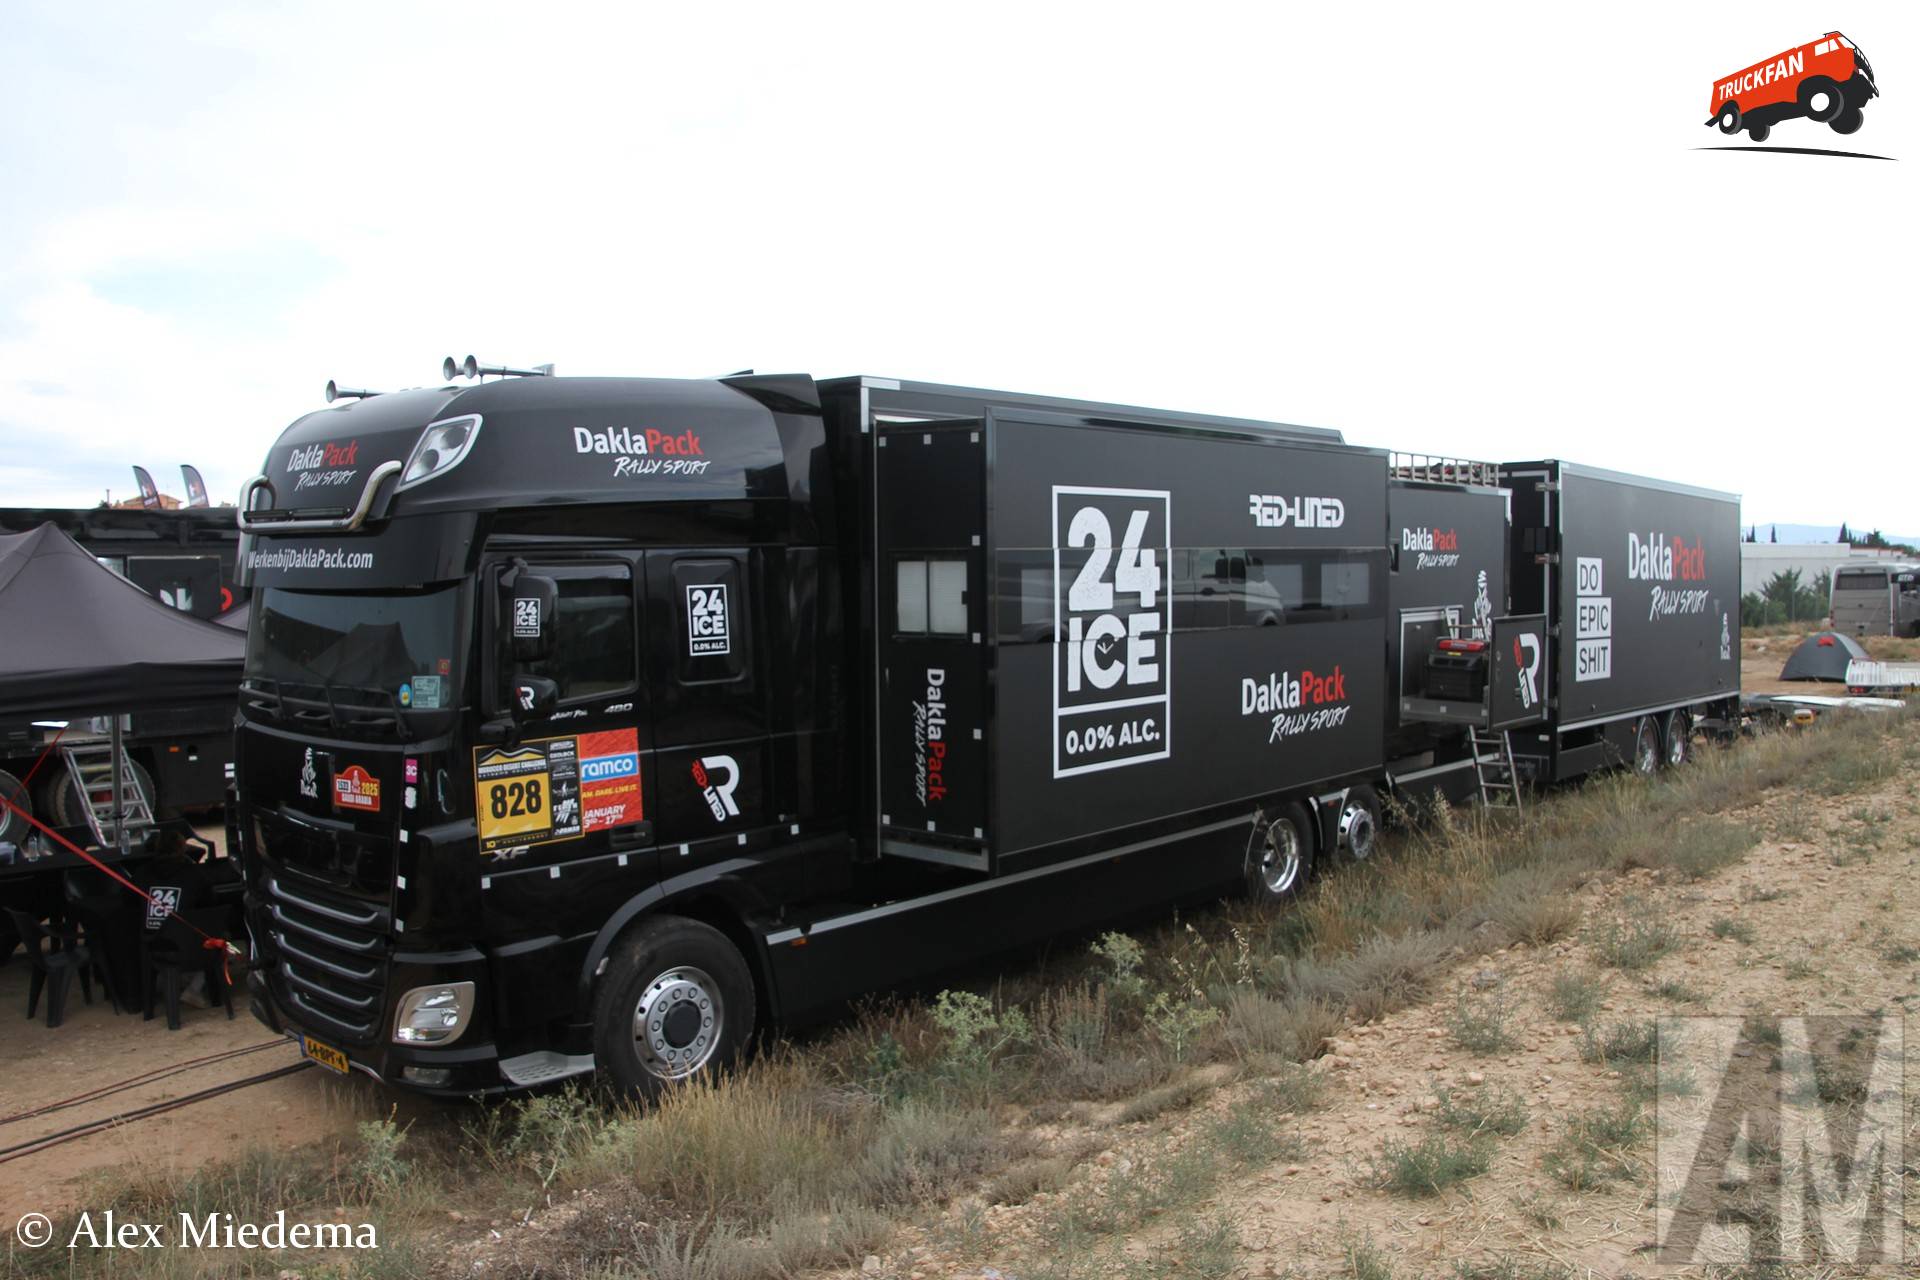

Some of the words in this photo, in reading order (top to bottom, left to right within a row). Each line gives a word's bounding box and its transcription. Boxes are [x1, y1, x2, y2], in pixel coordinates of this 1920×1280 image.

[573, 426, 705, 456] DaklaPack
[286, 440, 357, 473] DaklaPack
[614, 456, 662, 477] RALLY
[662, 460, 711, 474] SPORT
[294, 471, 324, 492] RALLY
[323, 469, 357, 486] SPORT
[1249, 494, 1345, 528] RED-LINED
[1402, 527, 1457, 551] DaklaPack
[248, 548, 373, 573] WerkenbijDaklaPack.com
[1067, 506, 1161, 611] 24
[1416, 552, 1438, 570] RALLY
[1437, 553, 1460, 567] SPORT
[1628, 531, 1706, 581] DaklaPack
[1579, 564, 1599, 591] DO
[517, 601, 537, 616] 24
[691, 589, 724, 616] 24
[1649, 585, 1680, 621] RALLY
[1679, 589, 1709, 615] SPORT
[516, 615, 537, 626] ICE
[692, 615, 725, 636] ICE
[1579, 604, 1609, 632] EPIC
[1067, 612, 1161, 692] ICE
[1579, 646, 1609, 674] SHIT
[1242, 665, 1346, 715] DaklaPack
[912, 701, 927, 753] RALLY
[927, 668, 946, 800] DaklaPack
[1065, 724, 1115, 755] 0.0%
[1118, 718, 1160, 746] ALC.
[1268, 711, 1312, 744] RALLY
[1308, 705, 1351, 730] SPORT
[581, 758, 633, 778] ramco
[915, 752, 927, 807] SPORT
[361, 782, 378, 797] 2025
[490, 779, 542, 819] 828
[584, 803, 627, 819] JANUARY
[151, 890, 176, 905] 24
